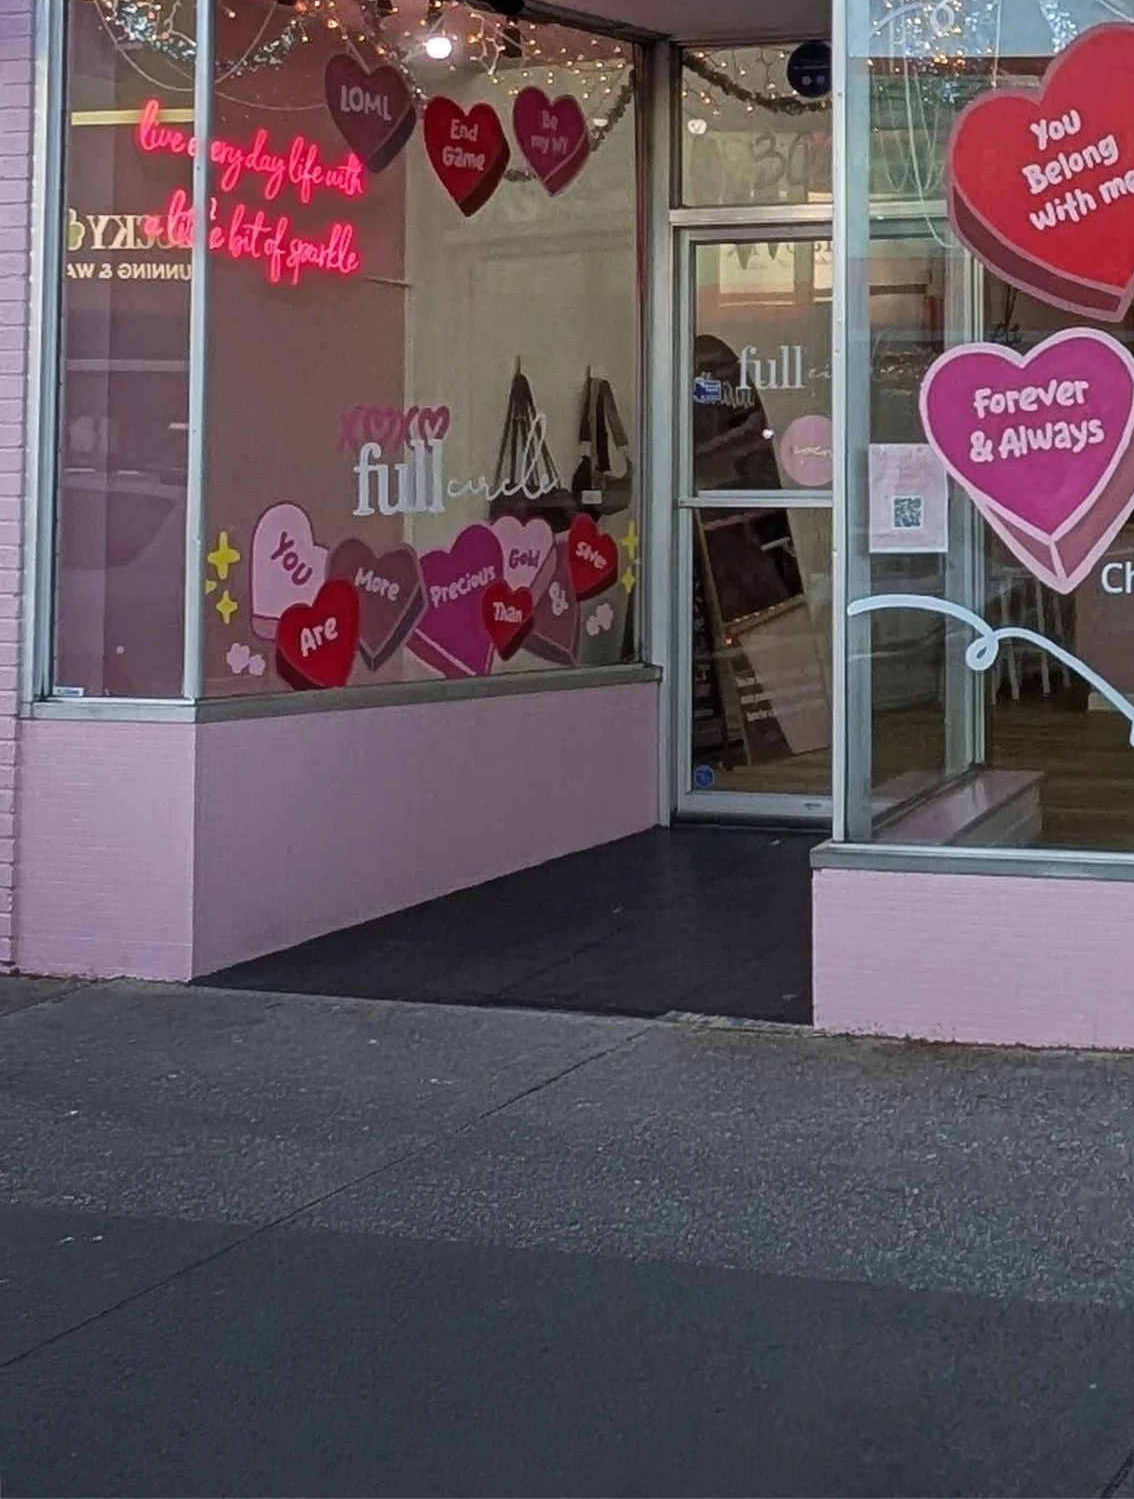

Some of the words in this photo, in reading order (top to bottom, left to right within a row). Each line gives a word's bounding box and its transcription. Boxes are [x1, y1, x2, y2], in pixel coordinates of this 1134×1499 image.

[341, 85, 391, 121] LOML
[451, 121, 479, 142] End
[1030, 109, 1082, 151] You
[139, 100, 185, 152] live
[289, 136, 323, 204] life
[325, 154, 363, 196] with
[442, 146, 486, 171] Game
[1021, 134, 1118, 195] Belong
[229, 204, 270, 258] bit
[264, 217, 287, 283] of
[287, 224, 359, 286] sparkle
[739, 344, 805, 390] full
[972, 377, 1089, 416] Forever
[969, 428, 993, 463] &
[998, 417, 1104, 460] Always
[353, 439, 445, 516] full
[447, 413, 560, 502] circle
[508, 548, 541, 571] Gold
[355, 567, 399, 602] More
[430, 565, 495, 608] Precious
[493, 601, 522, 623] Than
[300, 616, 338, 657] Are
